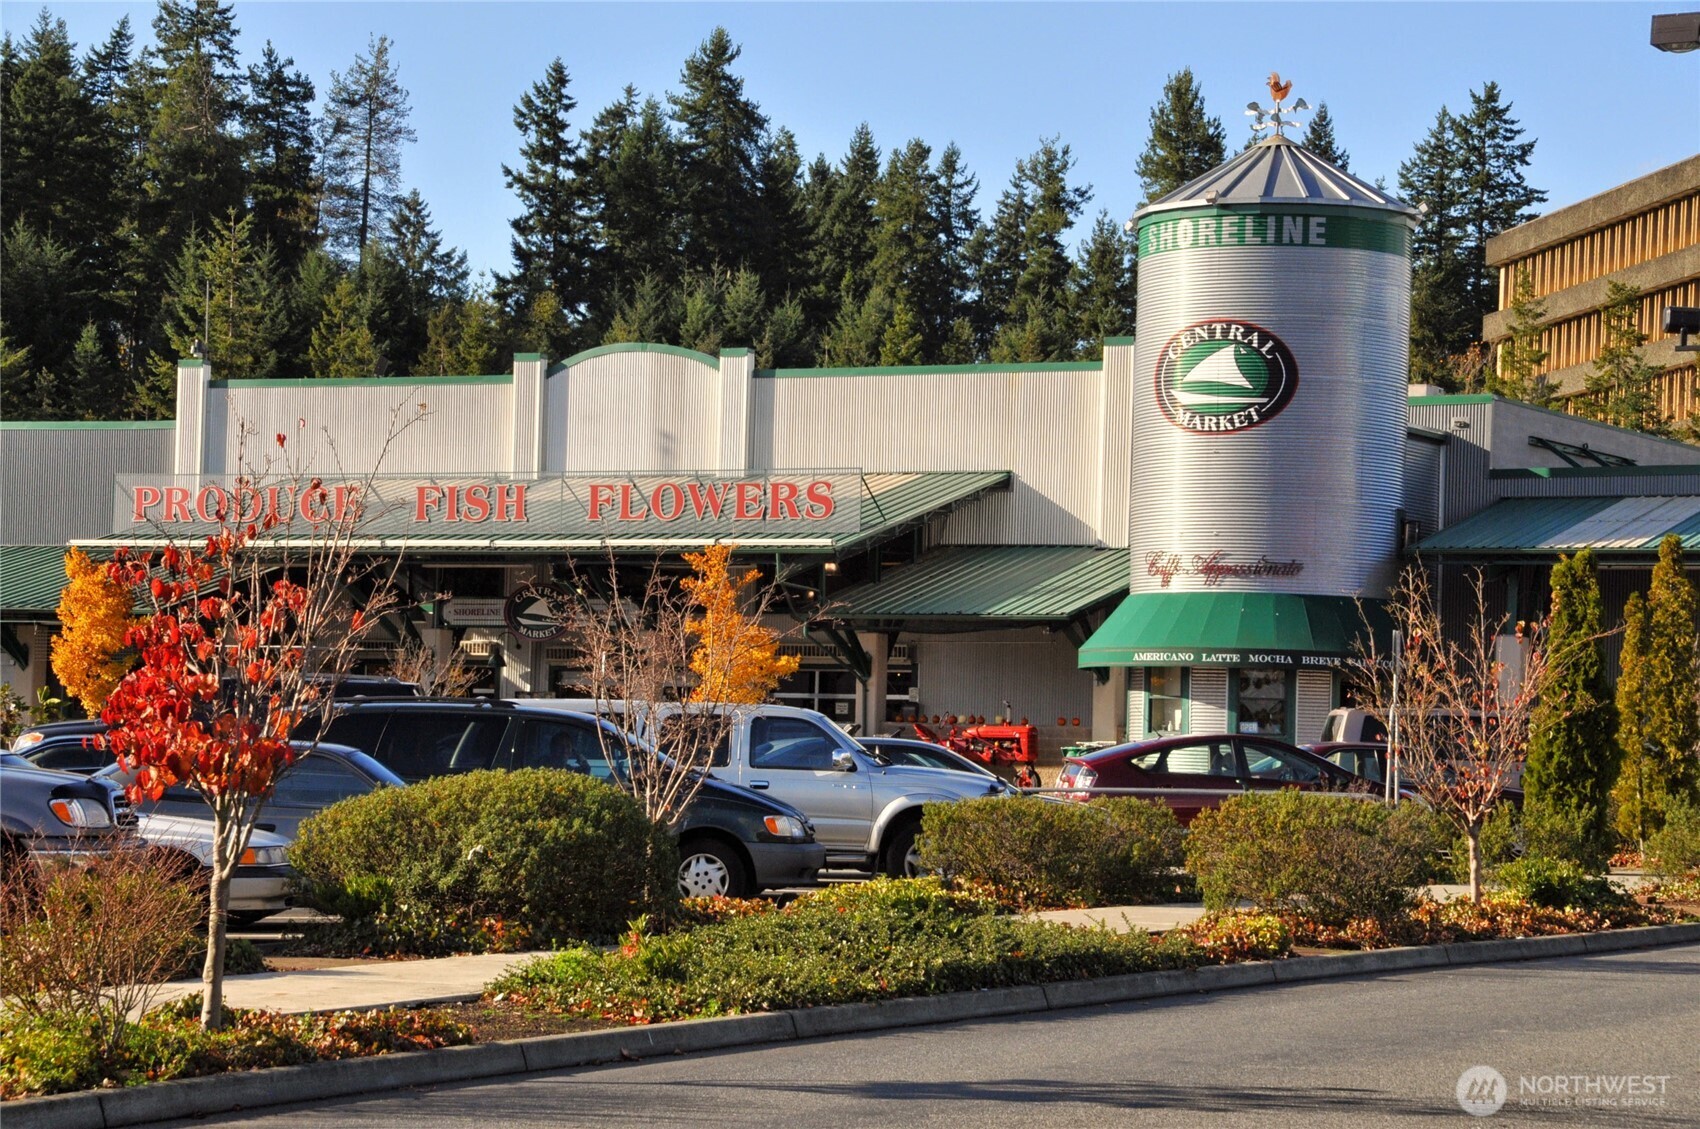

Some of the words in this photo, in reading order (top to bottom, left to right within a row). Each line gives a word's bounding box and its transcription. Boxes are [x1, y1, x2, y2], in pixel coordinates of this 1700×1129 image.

[1149, 215, 1326, 252] SHORELINE
[1168, 323, 1275, 360] CENTRAL
[1175, 405, 1261, 432] MARKET
[132, 485, 364, 524] PRODUCE
[414, 483, 529, 523] FISH
[587, 481, 835, 522] FLOWERS
[453, 608, 500, 617] SHORELINE
[518, 625, 557, 639] MARKET
[1132, 652, 1195, 662] AMERICANO
[1201, 653, 1240, 663] LATTE
[1248, 654, 1293, 664] MOCHA
[1301, 655, 1341, 667] BREVE
